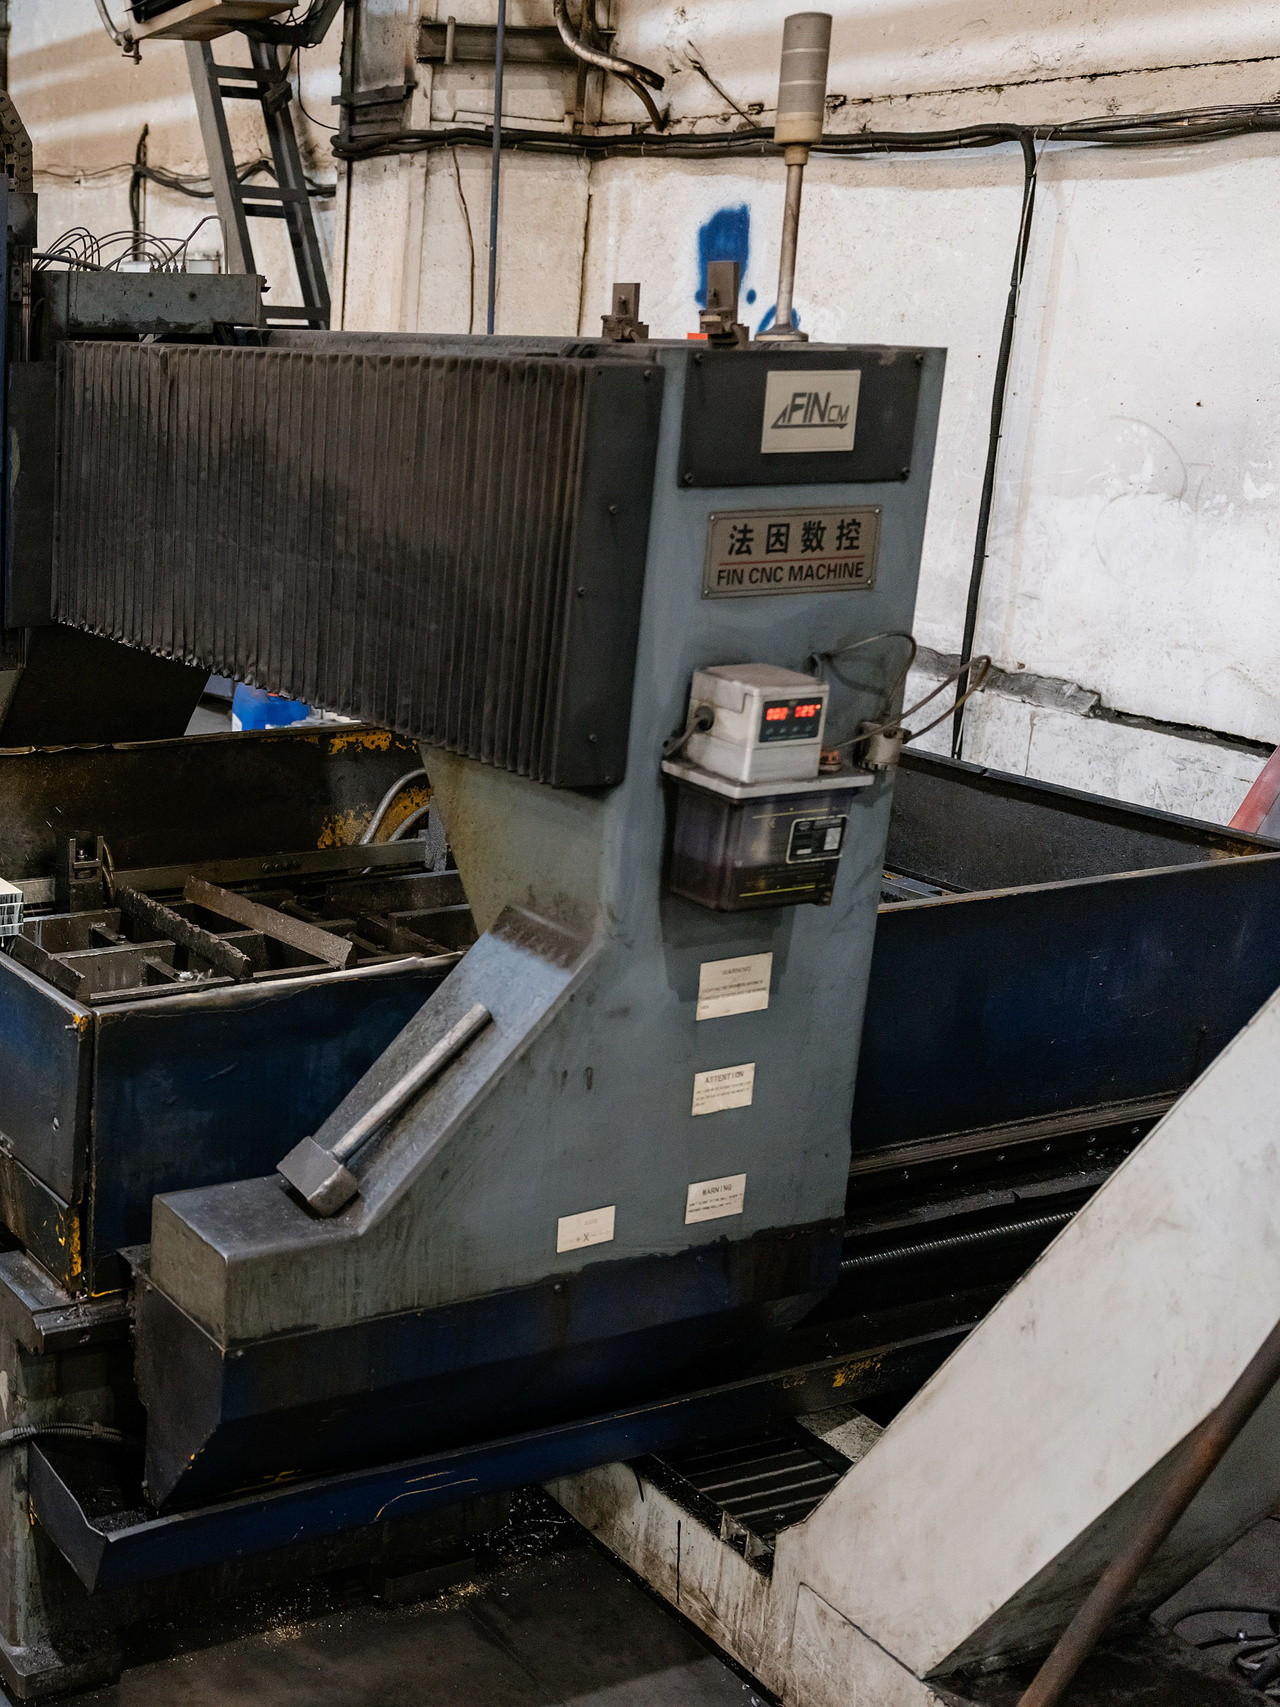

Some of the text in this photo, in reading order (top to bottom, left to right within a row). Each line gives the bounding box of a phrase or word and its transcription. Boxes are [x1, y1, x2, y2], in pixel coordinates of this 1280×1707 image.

[727, 518, 862, 556] 法因数控
[716, 561, 865, 587] FIN CNC MACHINE
[705, 1071, 745, 1083] ATTENTION
[701, 1184, 733, 1196] WARNING
